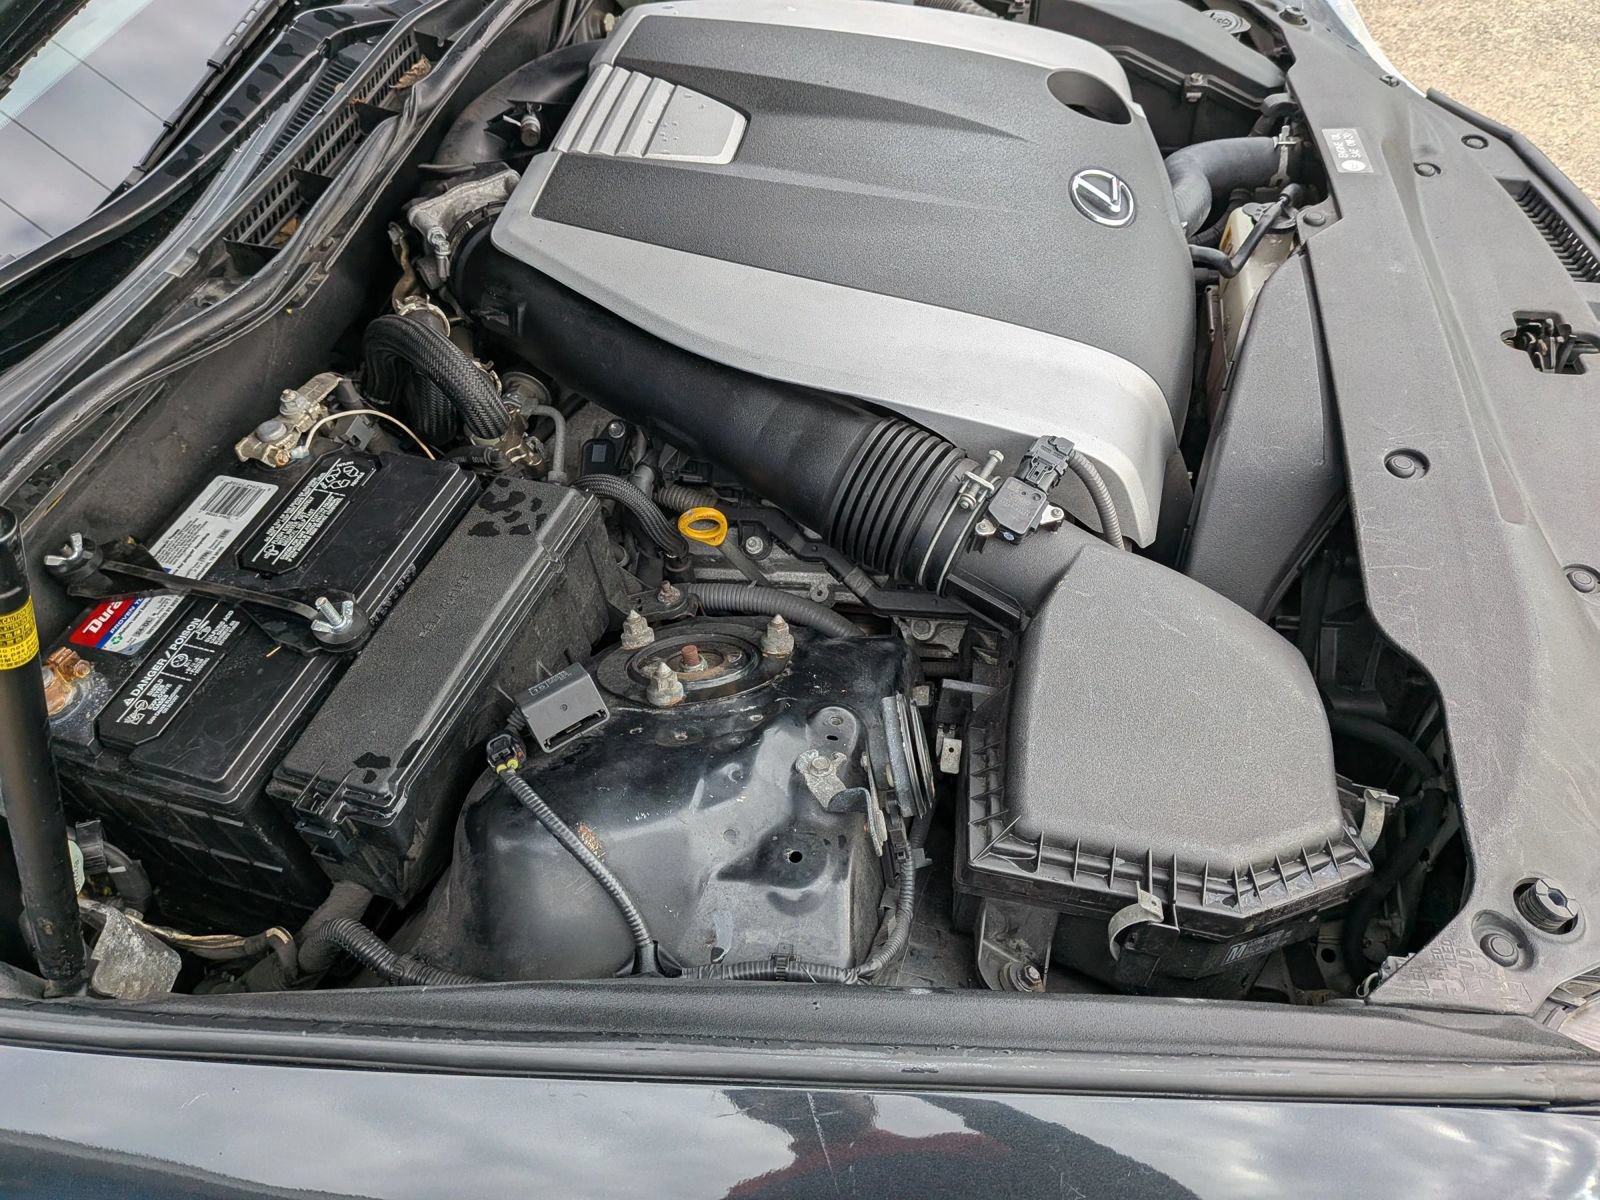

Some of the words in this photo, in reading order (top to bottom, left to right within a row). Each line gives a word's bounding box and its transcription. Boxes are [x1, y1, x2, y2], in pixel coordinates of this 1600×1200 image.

[109, 605, 137, 634] PROVEN
[129, 658, 168, 697] DANGER
[169, 617, 203, 651] POISON
